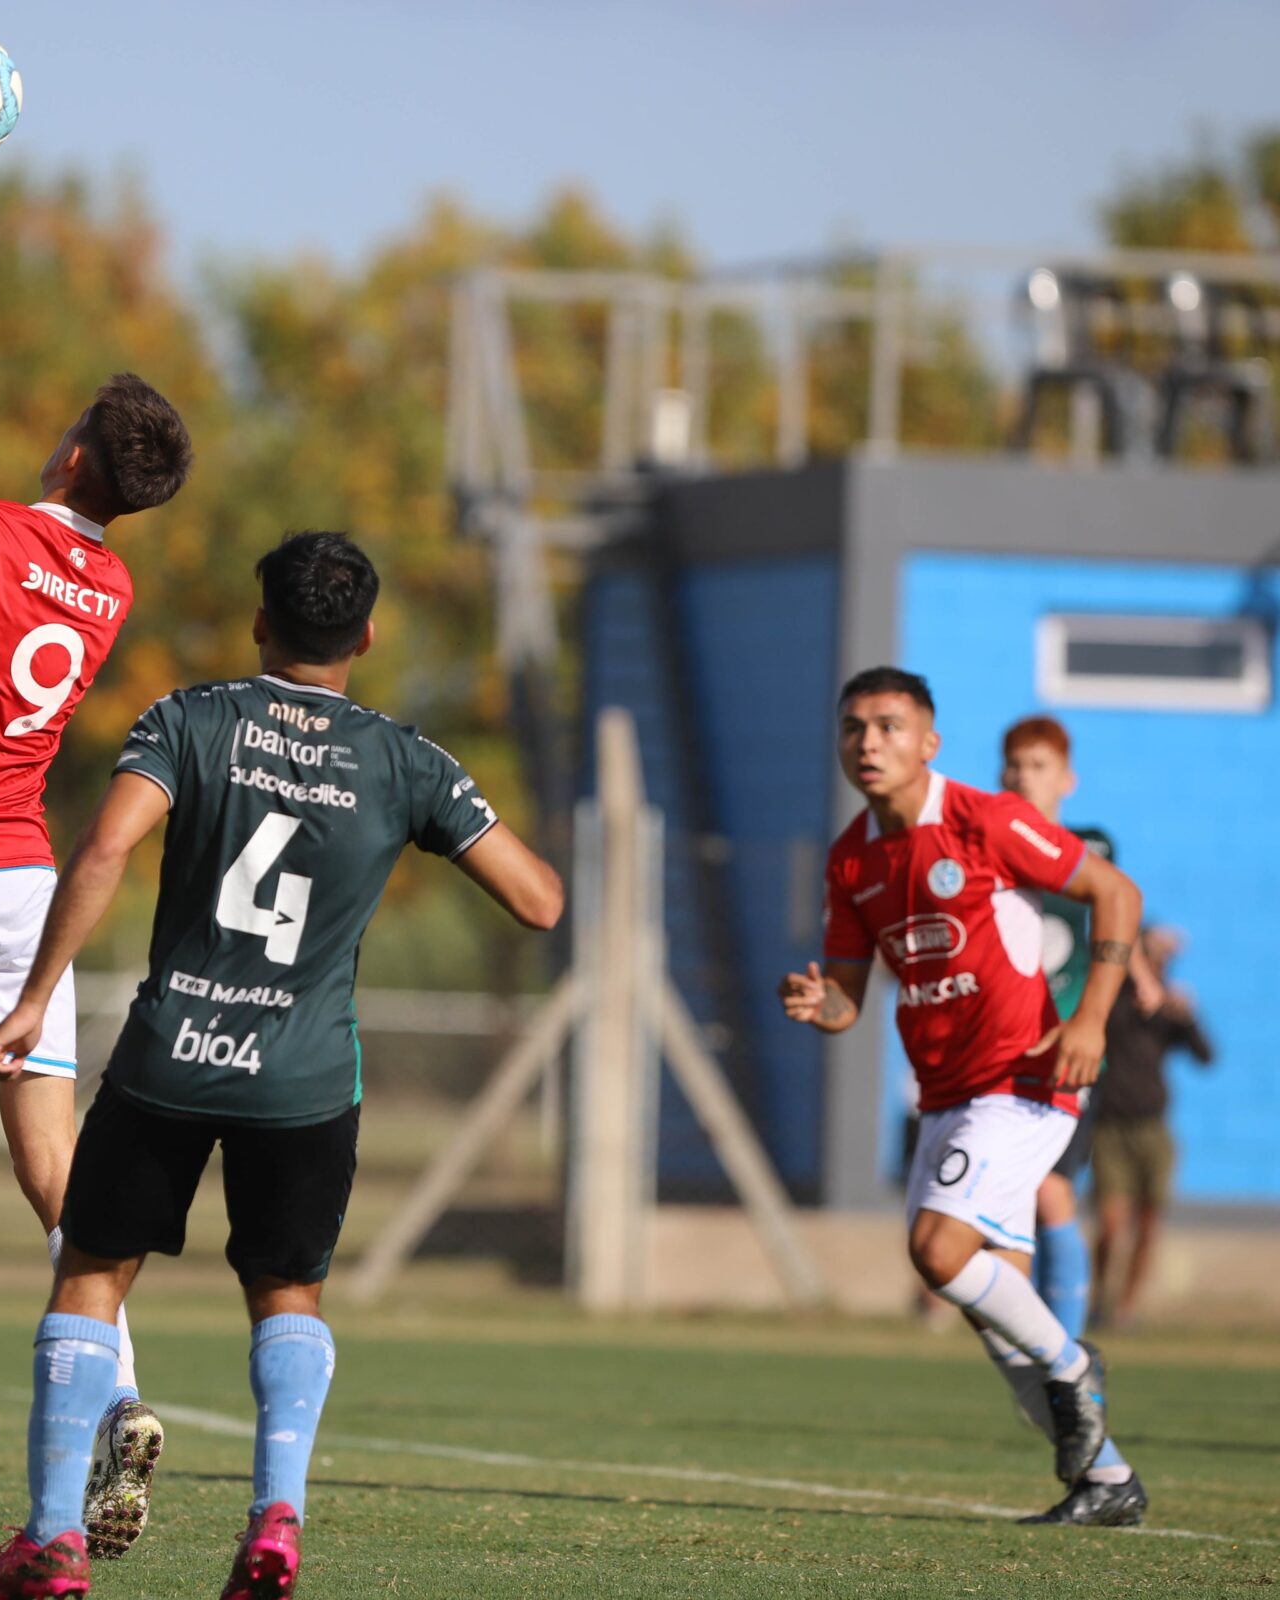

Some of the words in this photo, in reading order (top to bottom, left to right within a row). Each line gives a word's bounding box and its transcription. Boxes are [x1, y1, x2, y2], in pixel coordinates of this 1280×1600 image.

[21, 561, 120, 620] DIRECTV
[4, 623, 85, 737] 9
[244, 720, 329, 767] bancor
[268, 702, 331, 732] mitre
[215, 811, 313, 966] 4
[176, 975, 205, 993] YPF
[898, 972, 980, 1006] ANCOR
[171, 1013, 262, 1075] bio4
